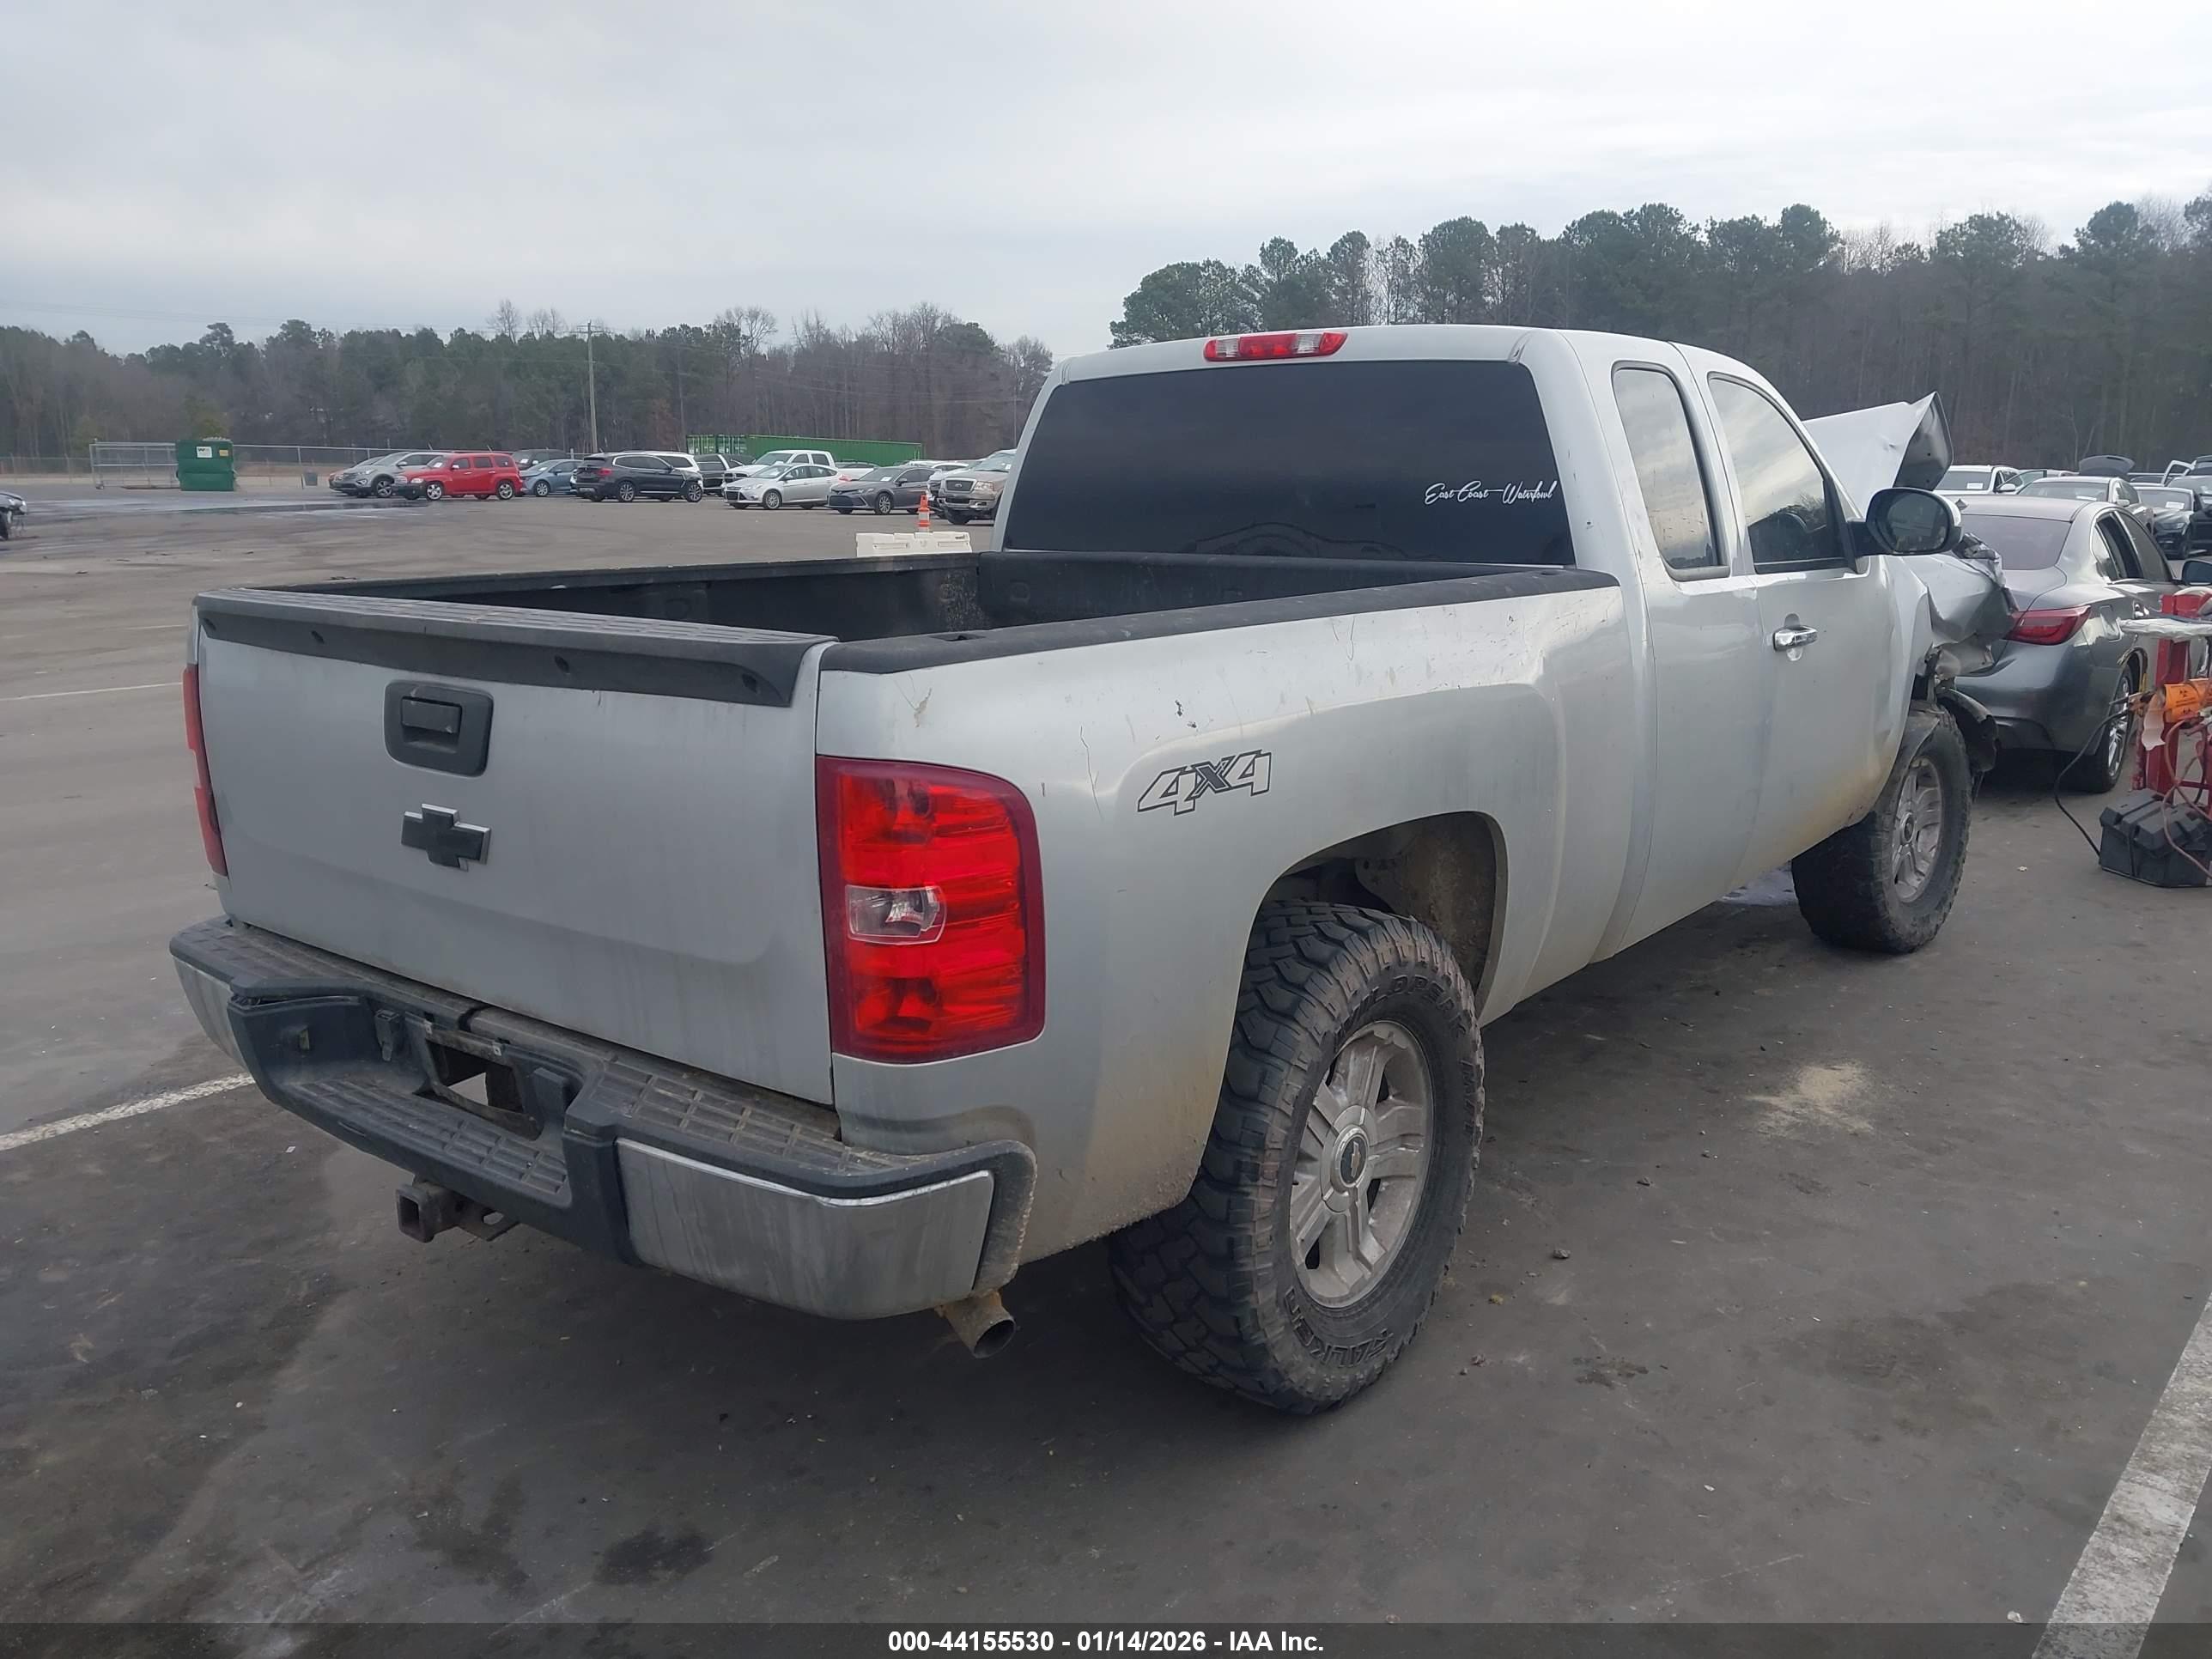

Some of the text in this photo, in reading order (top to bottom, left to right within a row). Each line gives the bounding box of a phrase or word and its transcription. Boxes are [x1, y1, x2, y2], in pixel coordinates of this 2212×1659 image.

[1425, 480, 1558, 505] East Coast Waterfowl
